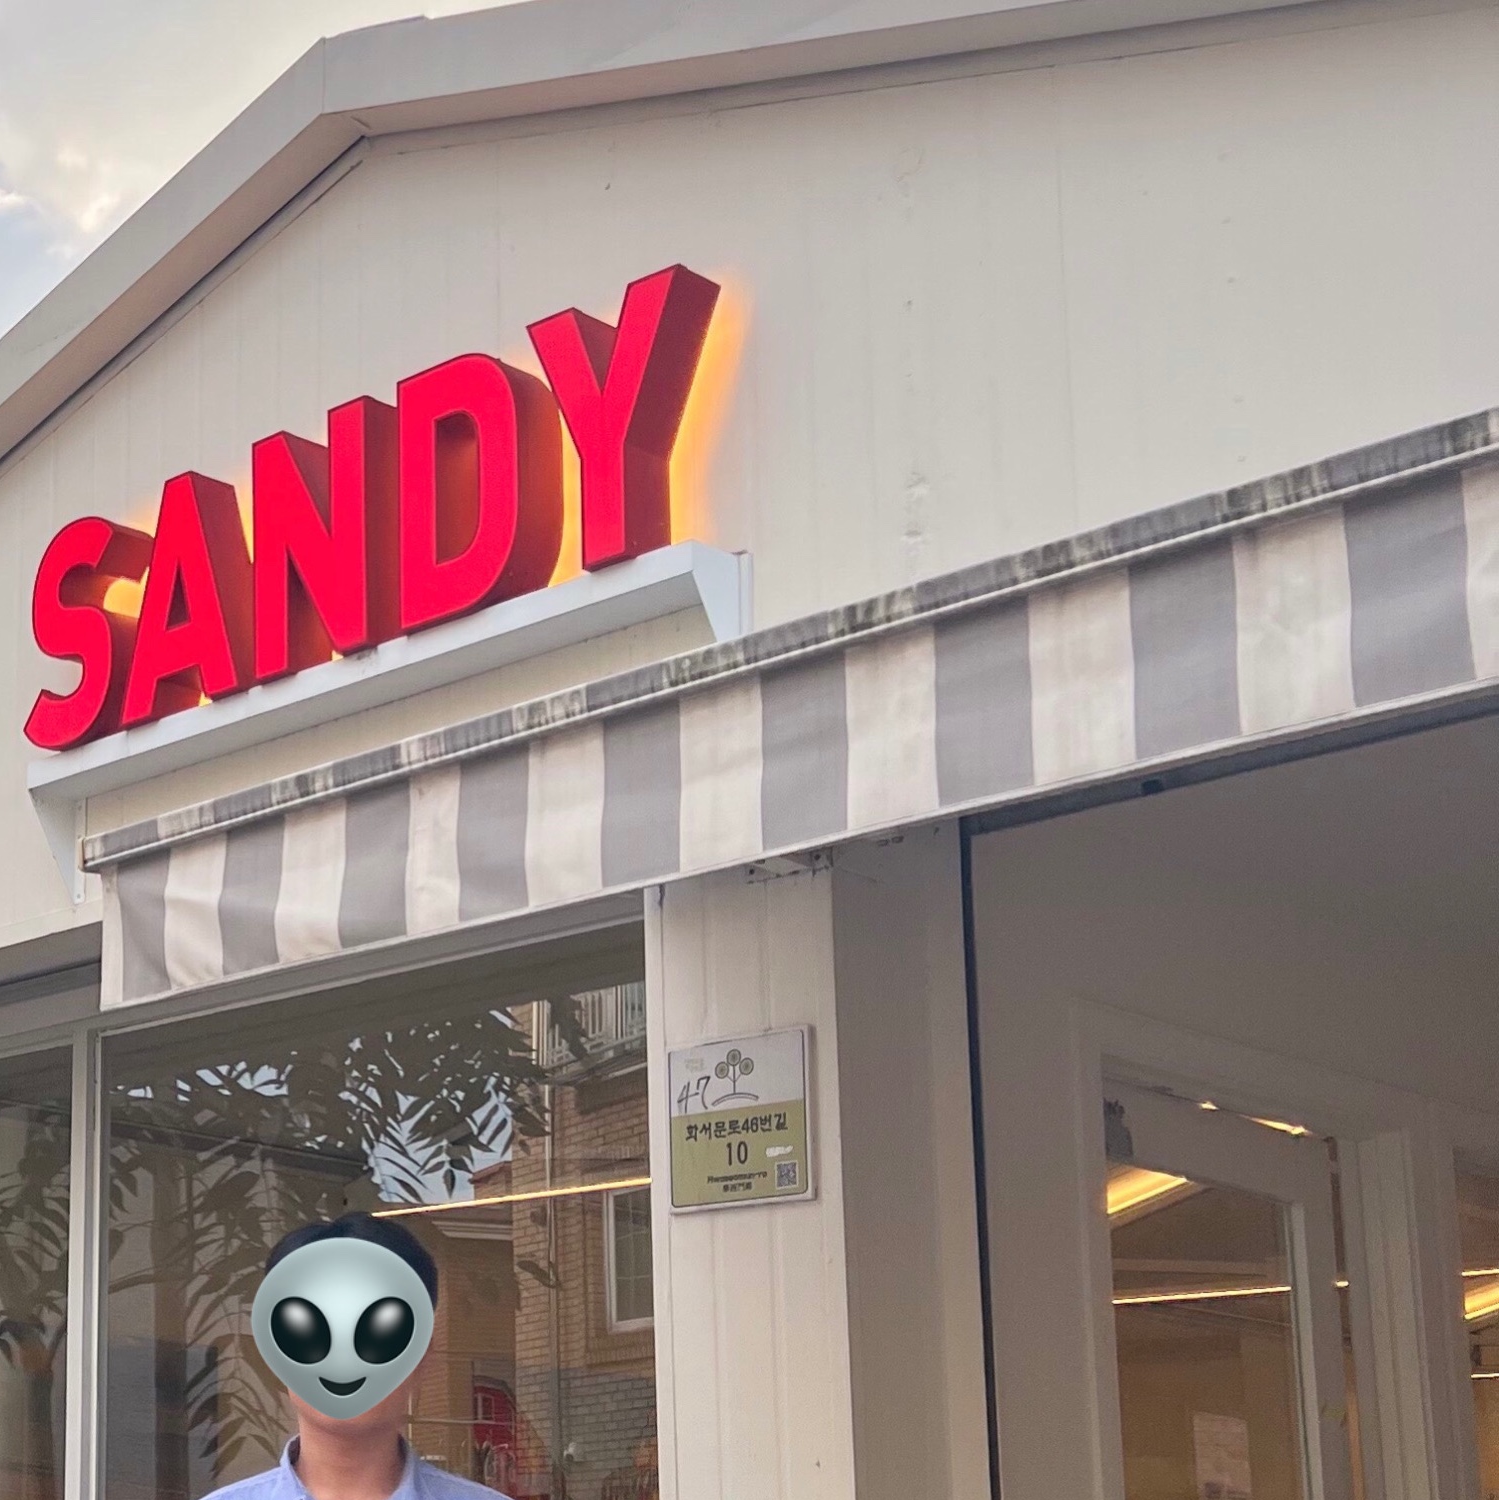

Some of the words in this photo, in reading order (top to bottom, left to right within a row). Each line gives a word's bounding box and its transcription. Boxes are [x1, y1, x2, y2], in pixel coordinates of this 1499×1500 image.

[24, 263, 721, 752] SANDY
[685, 1112, 788, 1142] 화서문로46번길
[726, 1141, 748, 1166] 10
